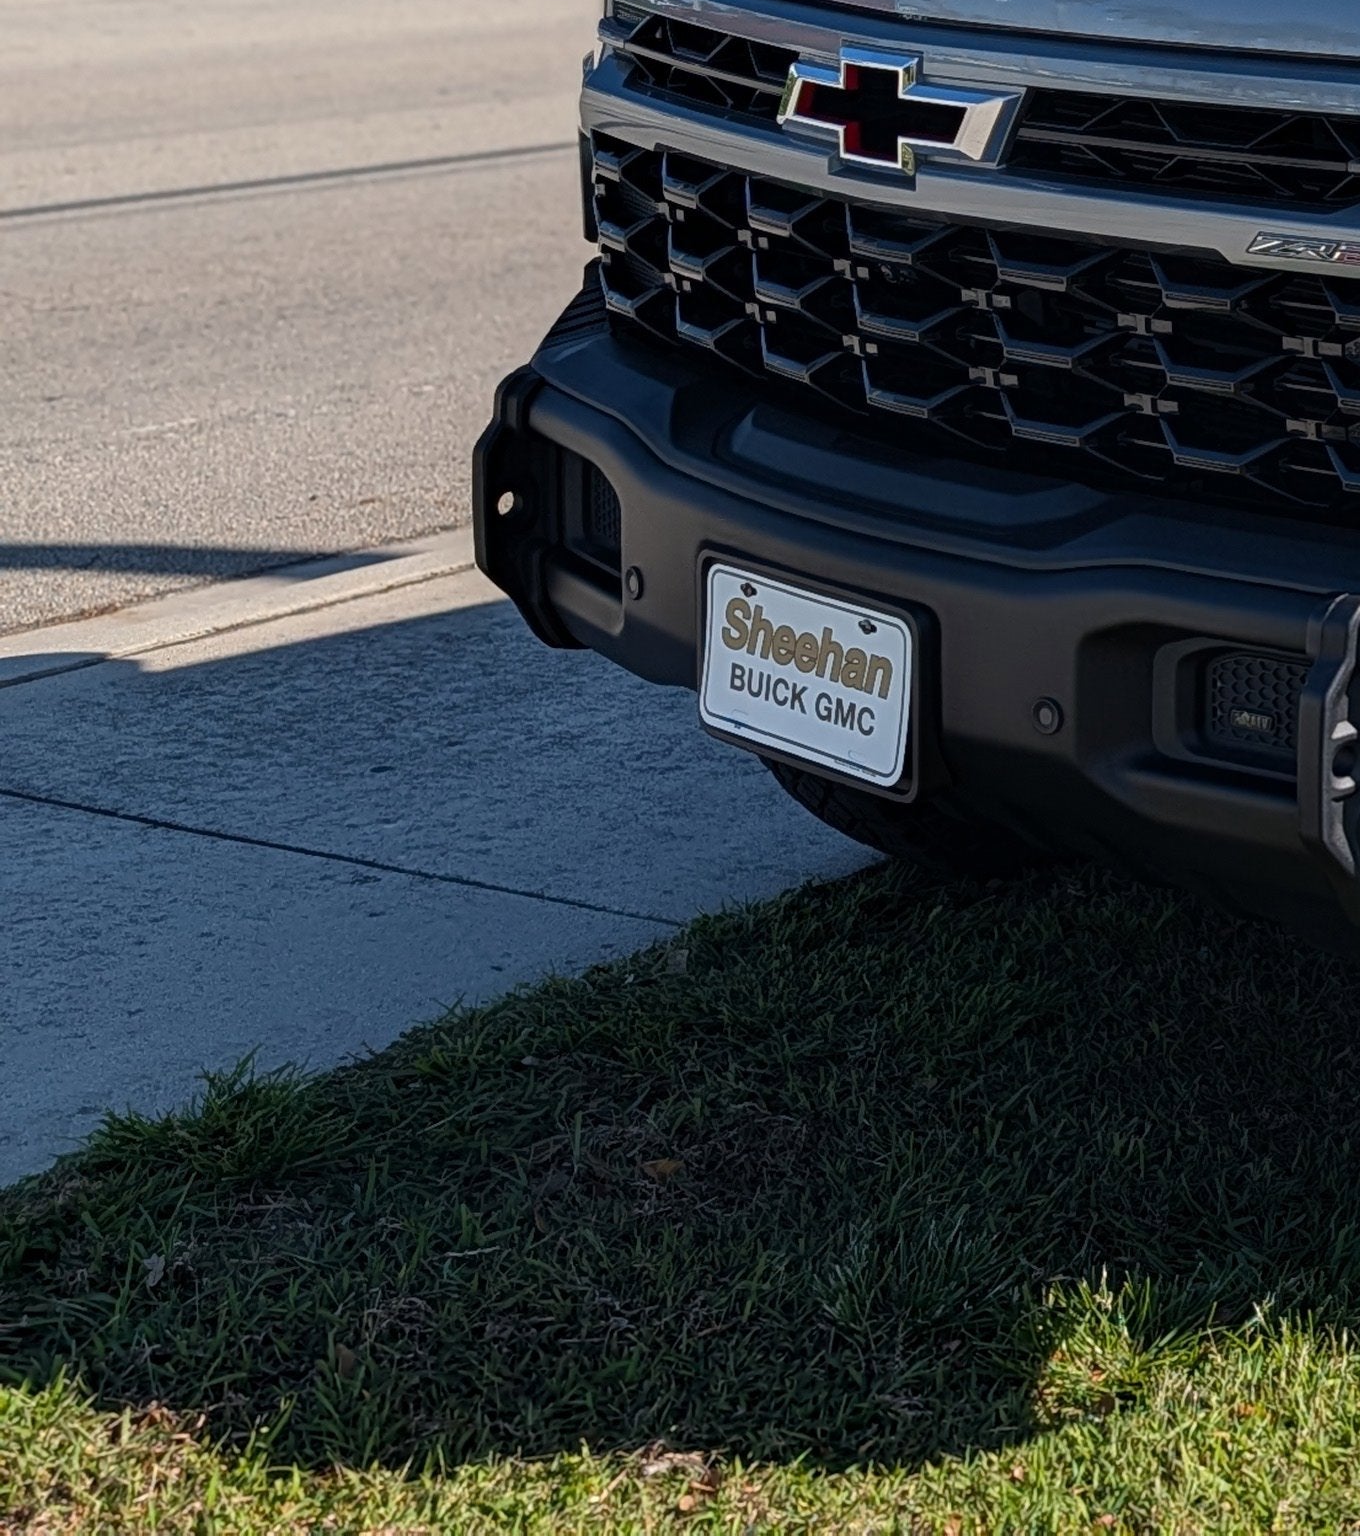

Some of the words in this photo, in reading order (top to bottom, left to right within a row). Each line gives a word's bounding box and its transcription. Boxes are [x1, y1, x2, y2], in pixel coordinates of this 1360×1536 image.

[721, 597, 894, 700] Sheehan
[729, 662, 809, 715] BUICK
[814, 691, 876, 737] GMC
